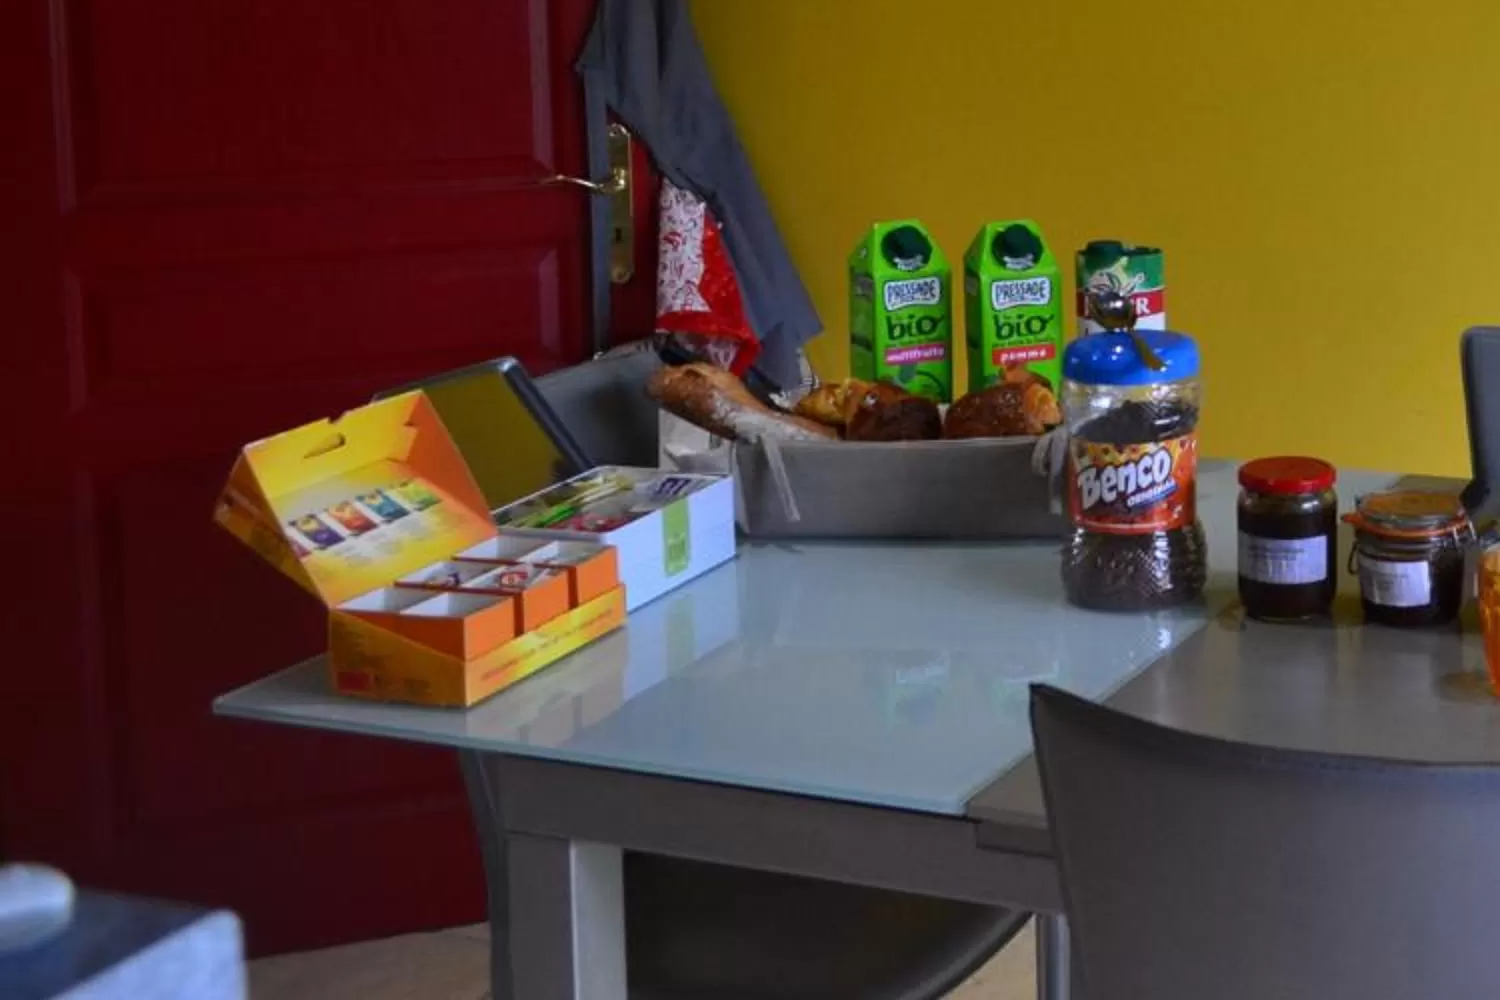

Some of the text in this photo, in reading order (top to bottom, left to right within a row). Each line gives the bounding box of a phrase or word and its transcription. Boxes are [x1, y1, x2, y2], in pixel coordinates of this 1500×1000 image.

[886, 315, 945, 341] bio
[993, 314, 1055, 341] bio
[1077, 449, 1171, 510] Benco
